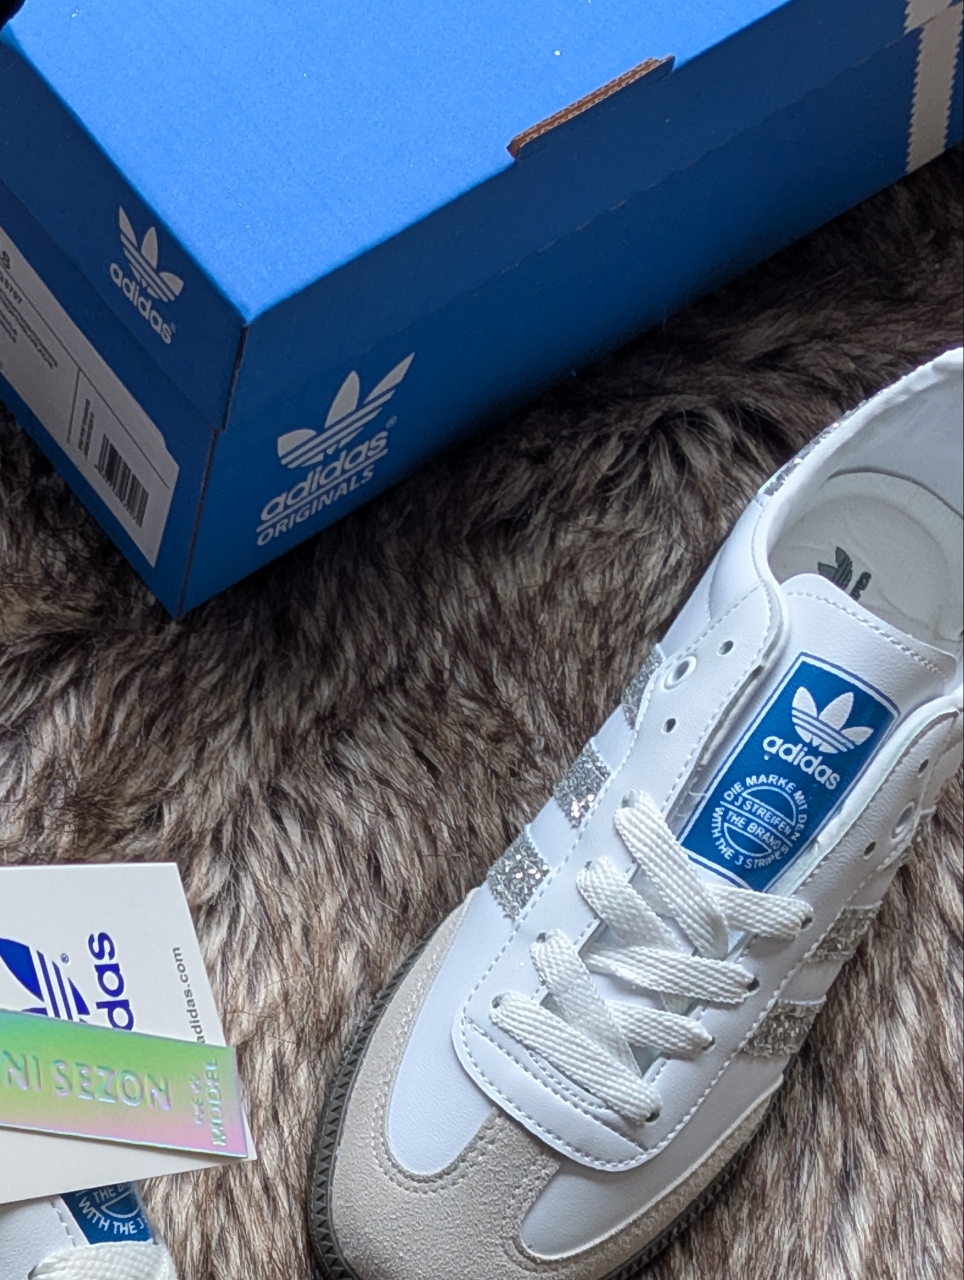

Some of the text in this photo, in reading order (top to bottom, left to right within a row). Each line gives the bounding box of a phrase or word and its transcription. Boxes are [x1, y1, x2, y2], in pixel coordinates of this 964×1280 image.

[109, 262, 172, 345] adidas
[260, 431, 388, 521] adidas
[256, 464, 375, 546] ORIGINALS
[762, 735, 841, 790] adidas
[723, 781, 745, 802] DIE
[745, 774, 797, 794] MARKE
[792, 790, 808, 811] MIT
[734, 795, 792, 836] 3 STREIFEN
[711, 806, 790, 870] WITH THE 3 STRIPES
[726, 810, 782, 850] THE BRAND
[88, 932, 134, 1031] das
[52, 1059, 172, 1111] SEZON
[204, 1056, 227, 1146] MODEL
[78, 1196, 111, 1232] WITH
[112, 1220, 138, 1236] THE
[92, 1185, 117, 1204] THE
